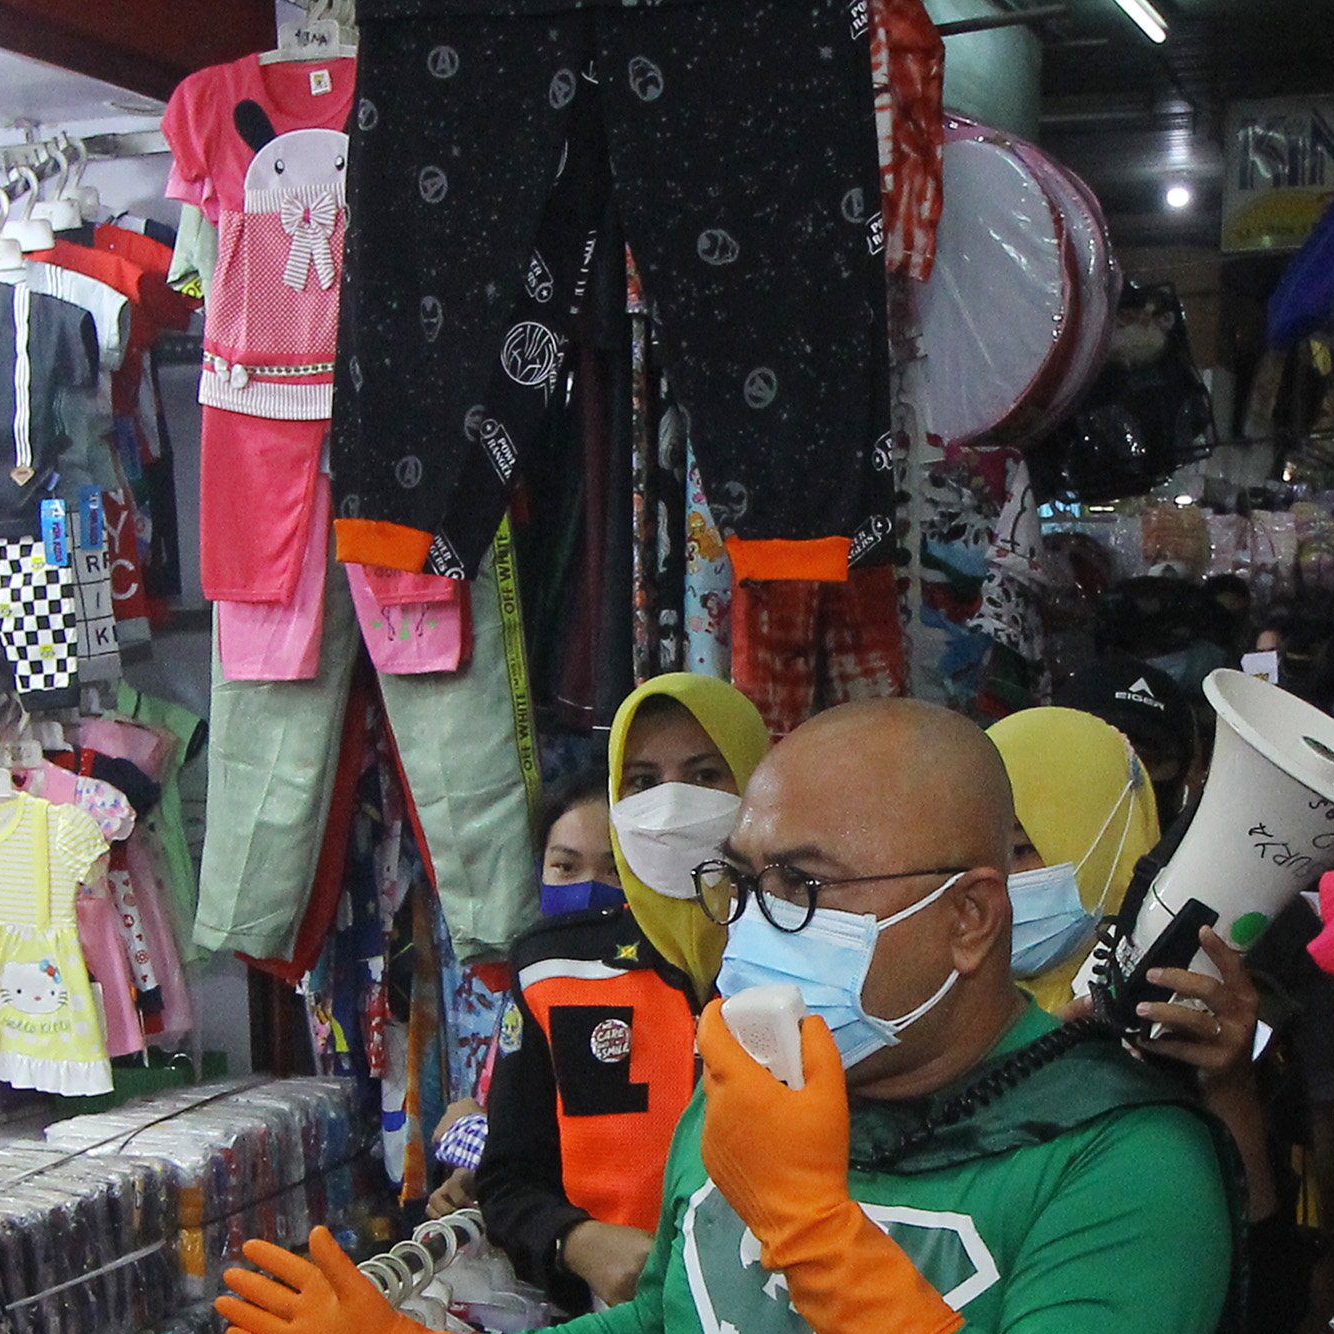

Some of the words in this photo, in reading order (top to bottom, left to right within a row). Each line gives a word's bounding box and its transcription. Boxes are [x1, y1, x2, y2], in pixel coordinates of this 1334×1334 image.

[1115, 692, 1165, 711] EIGER
[515, 692, 530, 739] WHITE
[520, 745, 533, 771] OFF
[597, 1028, 625, 1042] CARE
